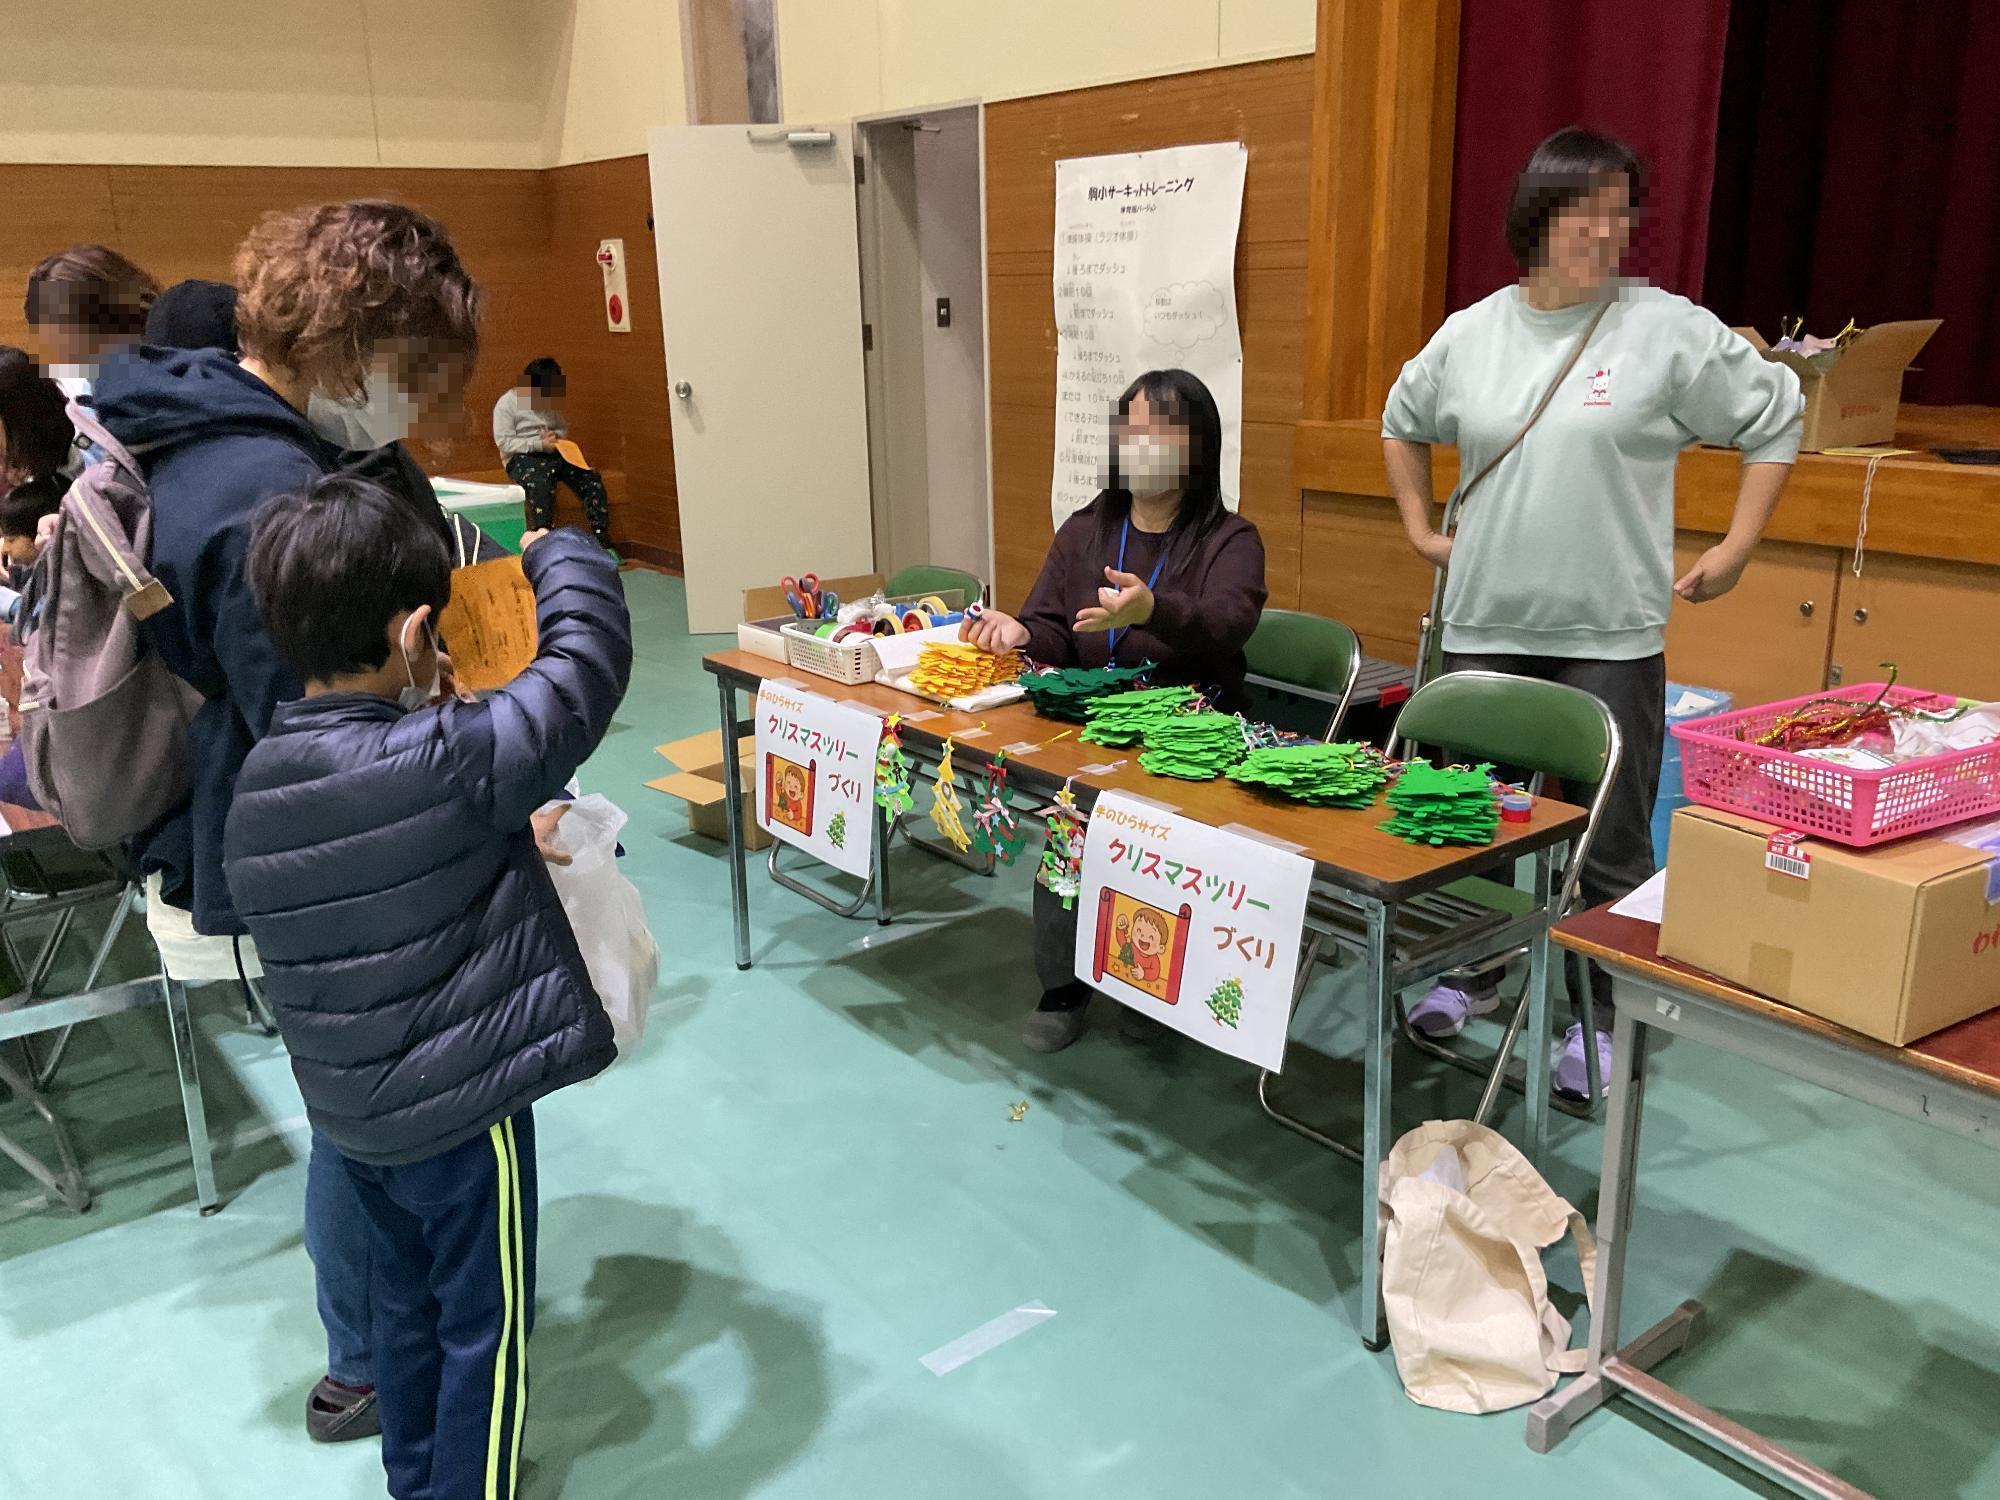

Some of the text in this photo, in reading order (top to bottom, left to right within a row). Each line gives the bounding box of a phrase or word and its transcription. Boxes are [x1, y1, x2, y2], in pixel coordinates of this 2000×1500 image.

[759, 689, 804, 713] 手のひらサイズ
[768, 714, 859, 761] クリスマスツリー
[828, 773, 861, 803] づくり
[1095, 804, 1172, 841] 手のひらサイズ
[1108, 838, 1270, 911] クリスマスツリー
[1213, 926, 1276, 969] づくり
